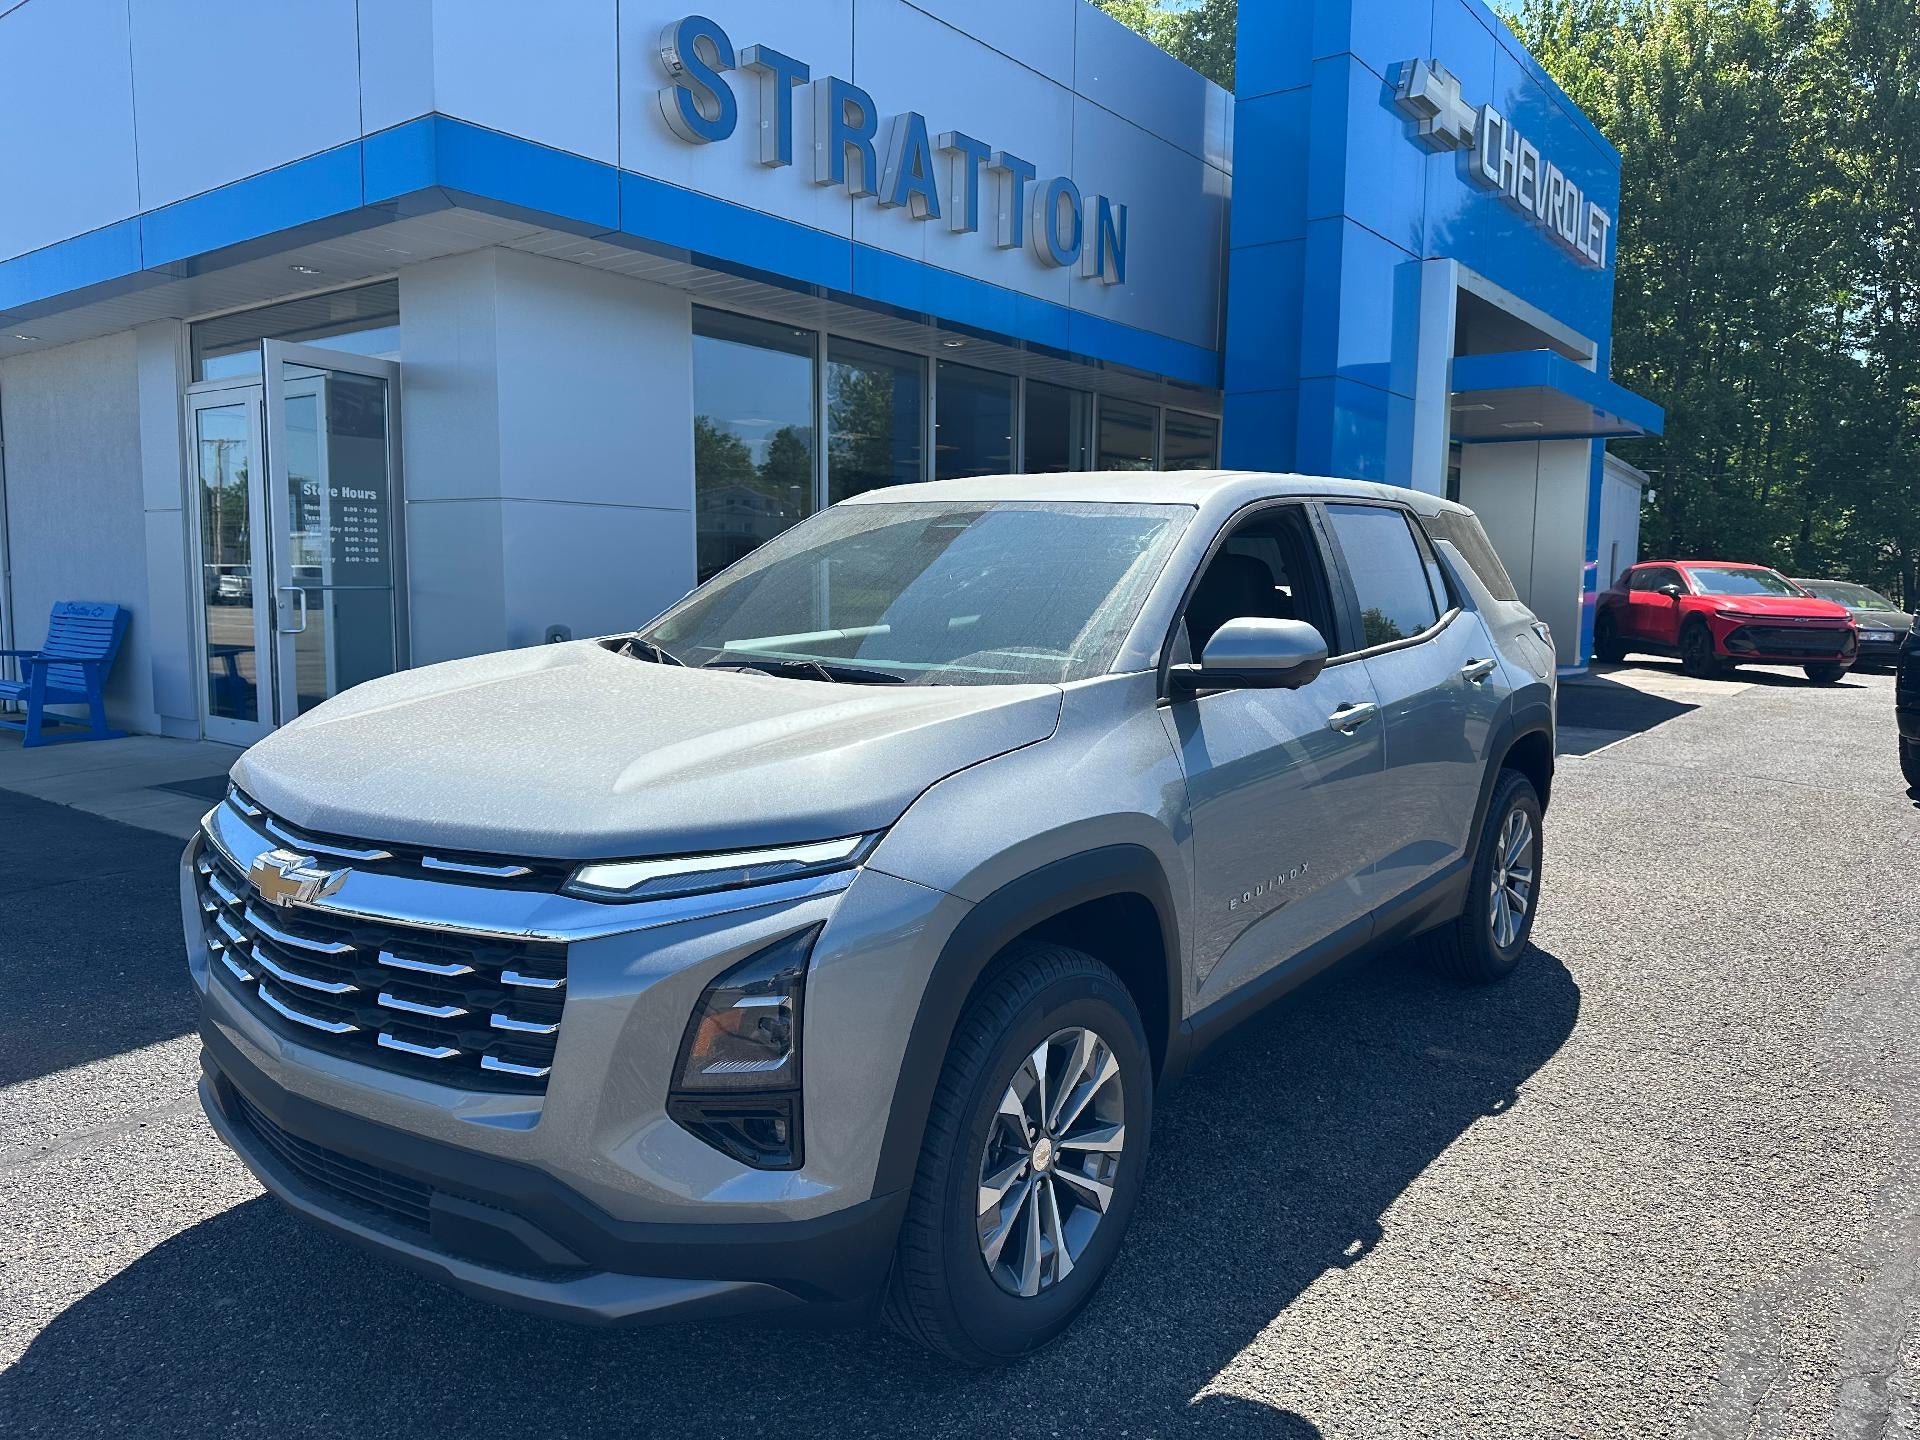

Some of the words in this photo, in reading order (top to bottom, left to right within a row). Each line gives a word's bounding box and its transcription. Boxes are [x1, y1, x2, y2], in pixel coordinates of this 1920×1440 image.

[659, 15, 1128, 285] STRATTON
[1477, 103, 1611, 269] CHEVROLET
[303, 483, 338, 497] Store
[341, 486, 377, 500] Hours
[1229, 860, 1309, 910] EQUINOX
